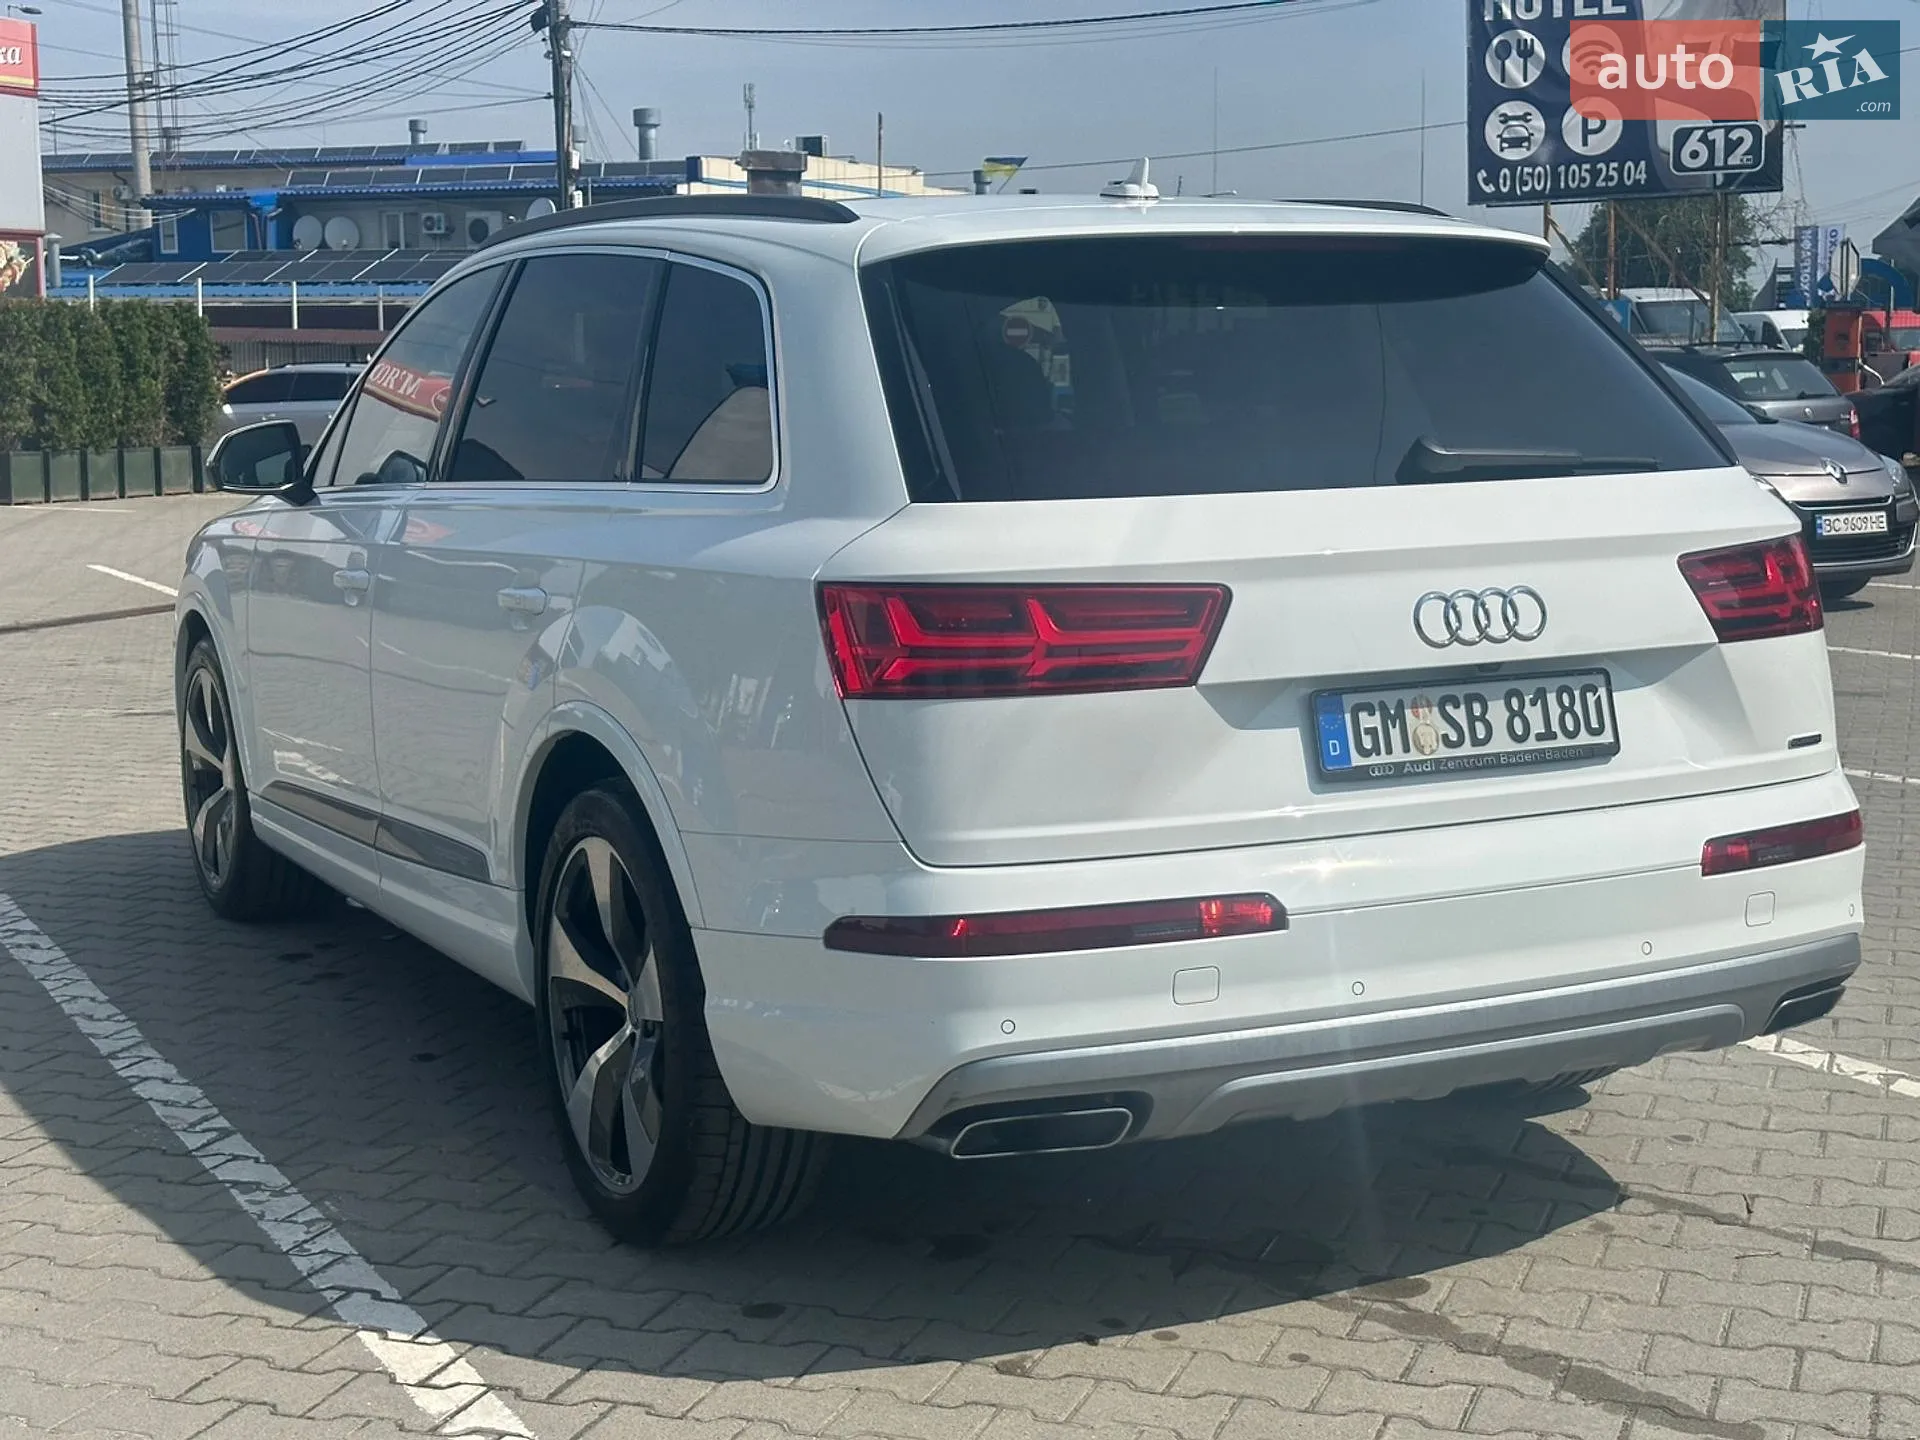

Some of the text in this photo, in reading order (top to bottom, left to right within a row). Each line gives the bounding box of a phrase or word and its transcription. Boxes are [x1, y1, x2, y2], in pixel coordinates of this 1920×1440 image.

[1680, 128, 1754, 169] 612
[1499, 160, 1647, 196] 0 (50) 105 25 04
[1329, 682, 1606, 758] D GM SB 8180
[1403, 747, 1584, 774] Audi Zentrum Baden-Baden
